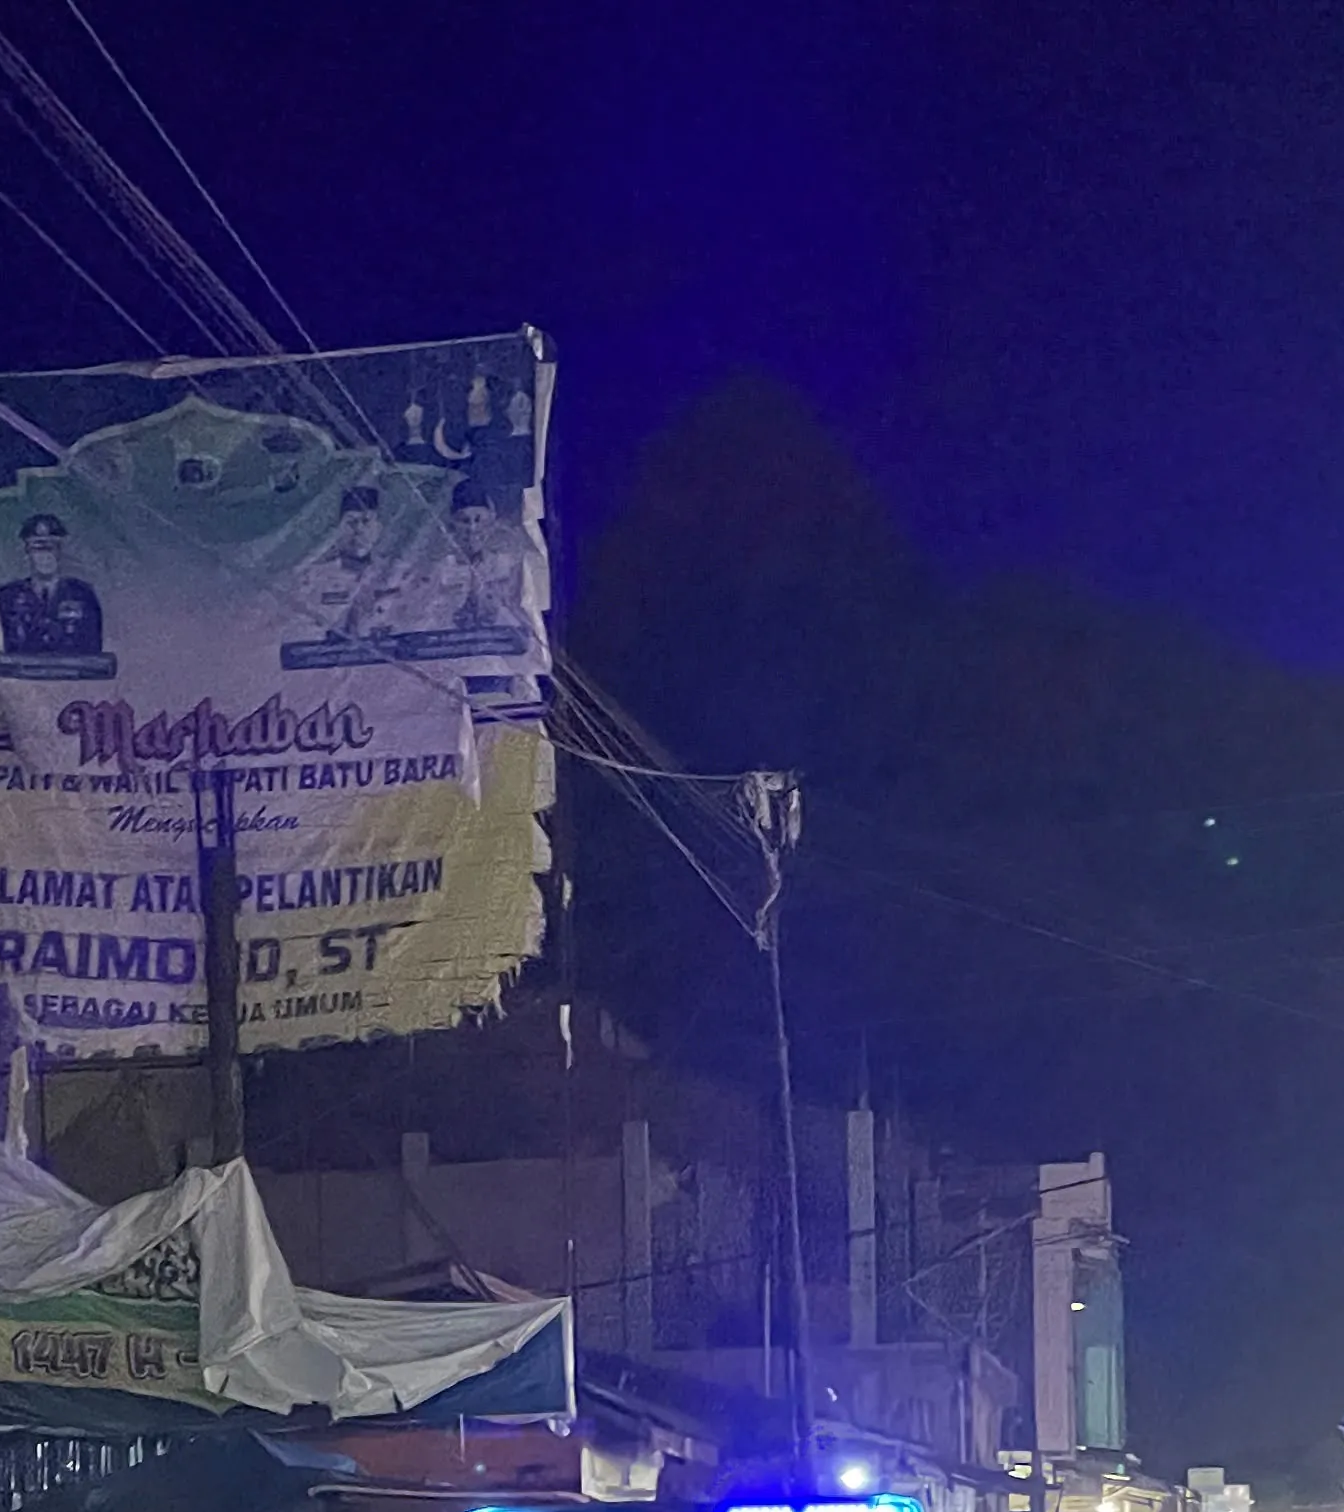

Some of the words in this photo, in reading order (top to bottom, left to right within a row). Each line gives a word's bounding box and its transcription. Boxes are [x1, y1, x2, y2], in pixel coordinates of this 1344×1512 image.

[299, 759, 374, 790] BATU
[383, 753, 457, 785] BARA
[131, 872, 206, 914] ATA
[234, 857, 443, 913] PELANTIKAN
[316, 922, 394, 975] ST
[168, 1002, 266, 1026] KEA
[11, 1329, 114, 1379] 1447
[126, 1333, 167, 1380] H
